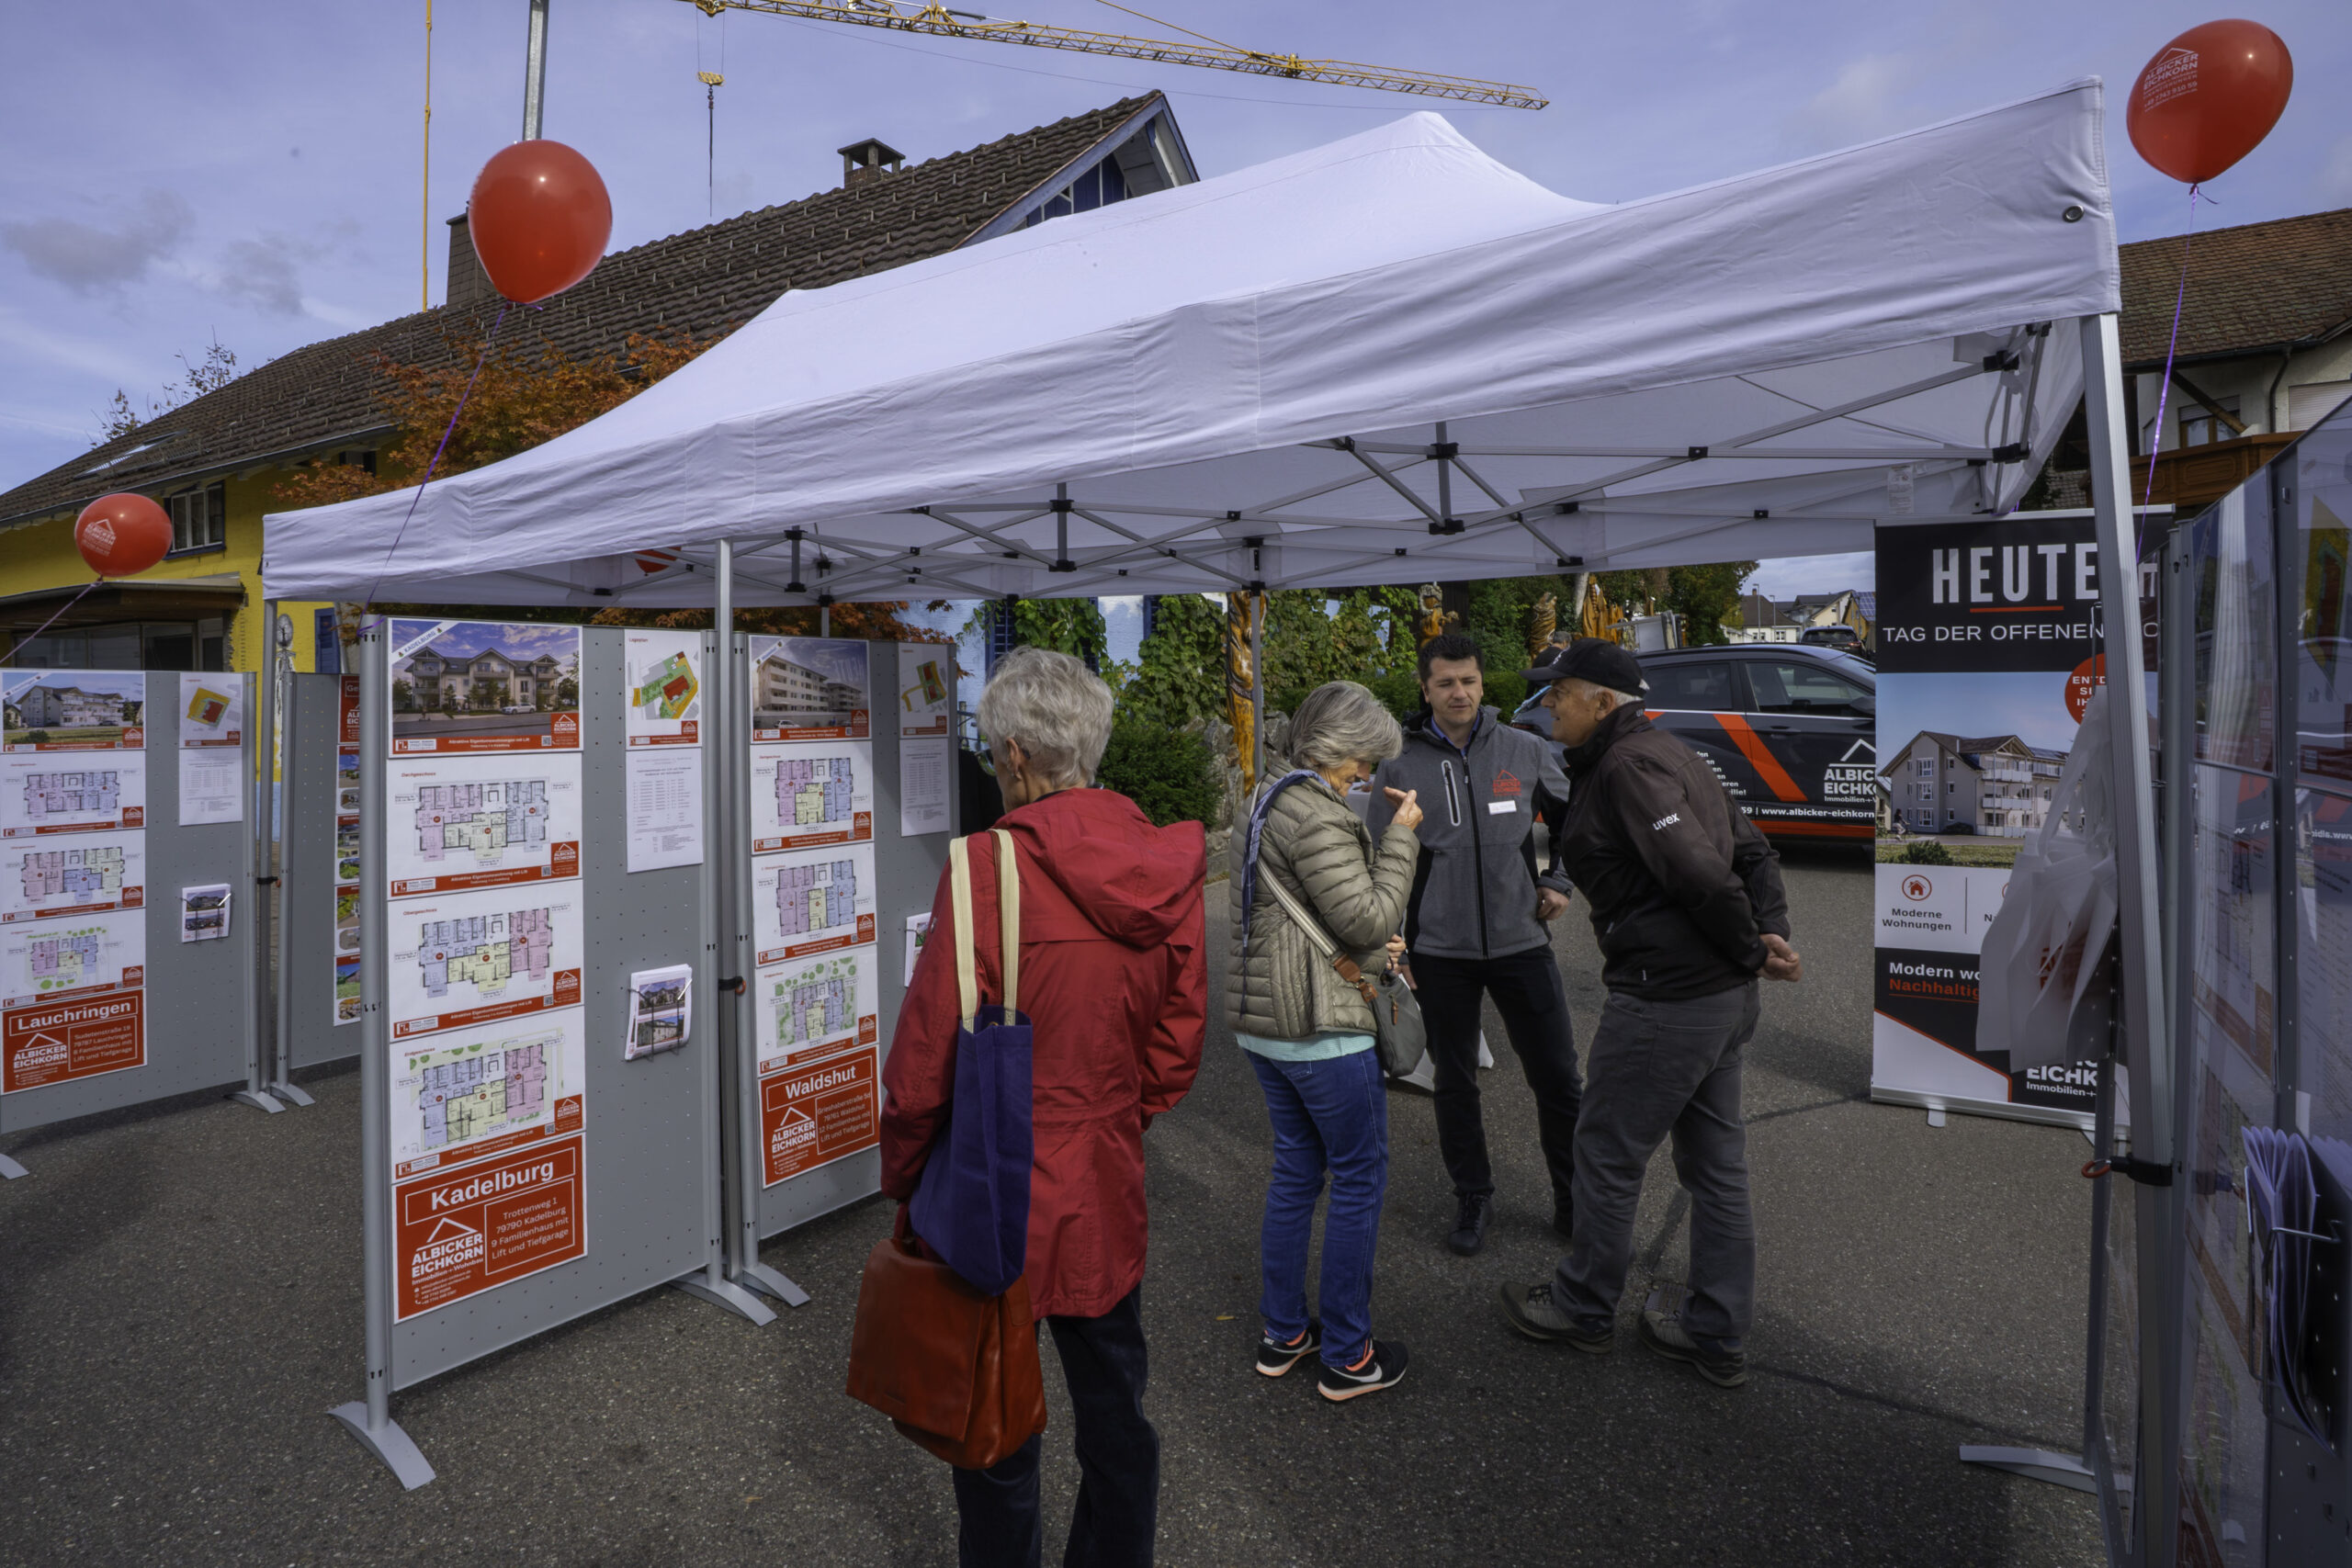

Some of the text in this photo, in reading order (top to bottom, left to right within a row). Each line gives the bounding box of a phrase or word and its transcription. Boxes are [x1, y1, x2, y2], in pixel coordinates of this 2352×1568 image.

[2143, 61, 2198, 90] EICHKORN
[2145, 53, 2199, 82] ALBICKER
[1933, 543, 2099, 604] HEUTE
[403, 630, 437, 653] KADELBURG
[1883, 623, 2105, 642] TAG DER OFFENEN
[1824, 768, 1876, 781] ALBIC
[1825, 783, 1876, 795] EICHK
[1652, 811, 1681, 830] uvex
[1762, 808, 1875, 818] www.albicker-eichkorn
[1891, 908, 1942, 919] Moderne
[1882, 919, 1952, 932] Wohnungen
[1889, 962, 1954, 979] Modern
[17, 1001, 131, 1031] Lauchringen
[14, 1044, 67, 1061] ALBICKER
[14, 1052, 67, 1069] EICHKORN
[786, 1066, 856, 1100] Waldshut
[2027, 1066, 2098, 1087] EICHK
[2027, 1081, 2086, 1097] Immobilien
[840, 1104, 865, 1117] Waldshut
[772, 1121, 816, 1144] ALBICKER
[772, 1130, 816, 1154] EICHKORN
[431, 1161, 554, 1211] Kadelburg
[503, 1197, 558, 1220] Trottenweg 1
[492, 1216, 569, 1247] 9 Familienhaus mit
[496, 1206, 566, 1235] 79790 Kadelburg
[412, 1233, 483, 1266] ALBICKER
[492, 1229, 569, 1260] Lift und Tiefgarage
[412, 1245, 483, 1279] EICHKORN
[412, 1269, 447, 1286] Immobilien
[454, 1258, 483, 1271] Wohnbau
